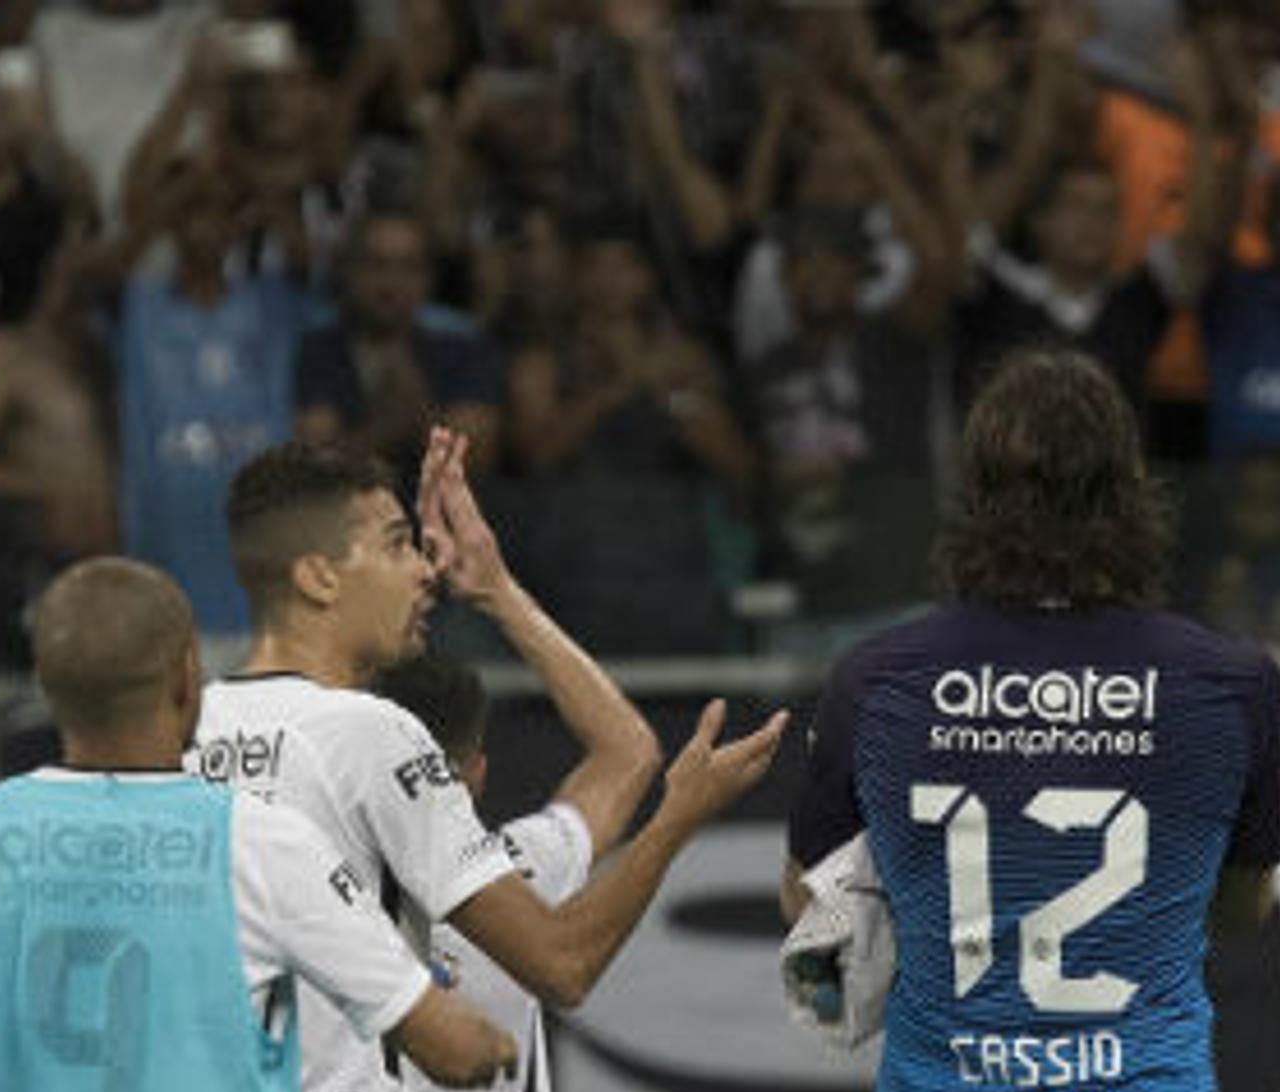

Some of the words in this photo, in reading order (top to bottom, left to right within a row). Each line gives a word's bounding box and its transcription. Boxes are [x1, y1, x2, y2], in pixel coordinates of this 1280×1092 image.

[932, 664, 1158, 722] alcatel
[930, 724, 1156, 756] smartphones
[909, 783, 1150, 1014] 12
[949, 1031, 1122, 1087] CASSIO
